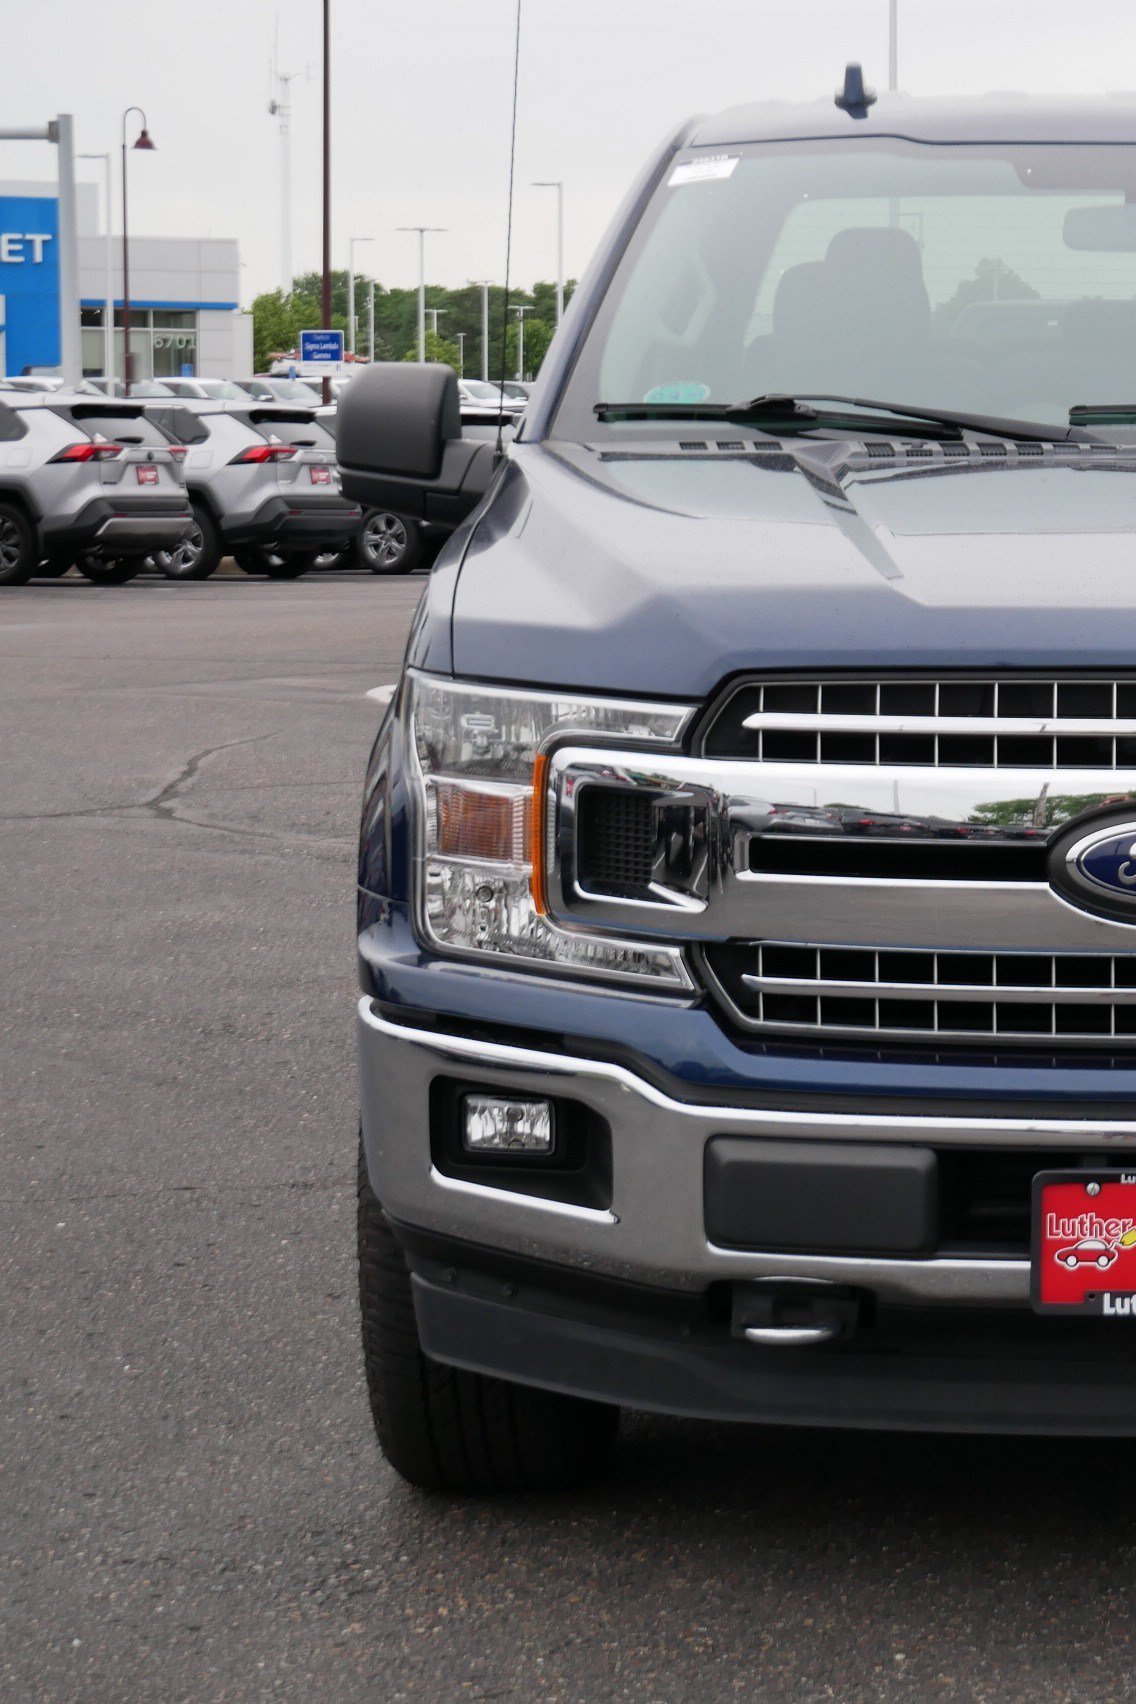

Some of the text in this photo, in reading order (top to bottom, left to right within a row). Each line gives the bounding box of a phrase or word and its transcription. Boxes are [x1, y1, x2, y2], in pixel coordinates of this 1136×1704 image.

[0, 233, 52, 263] ET
[153, 333, 196, 349] 6701
[1046, 1212, 1134, 1240] Luther
